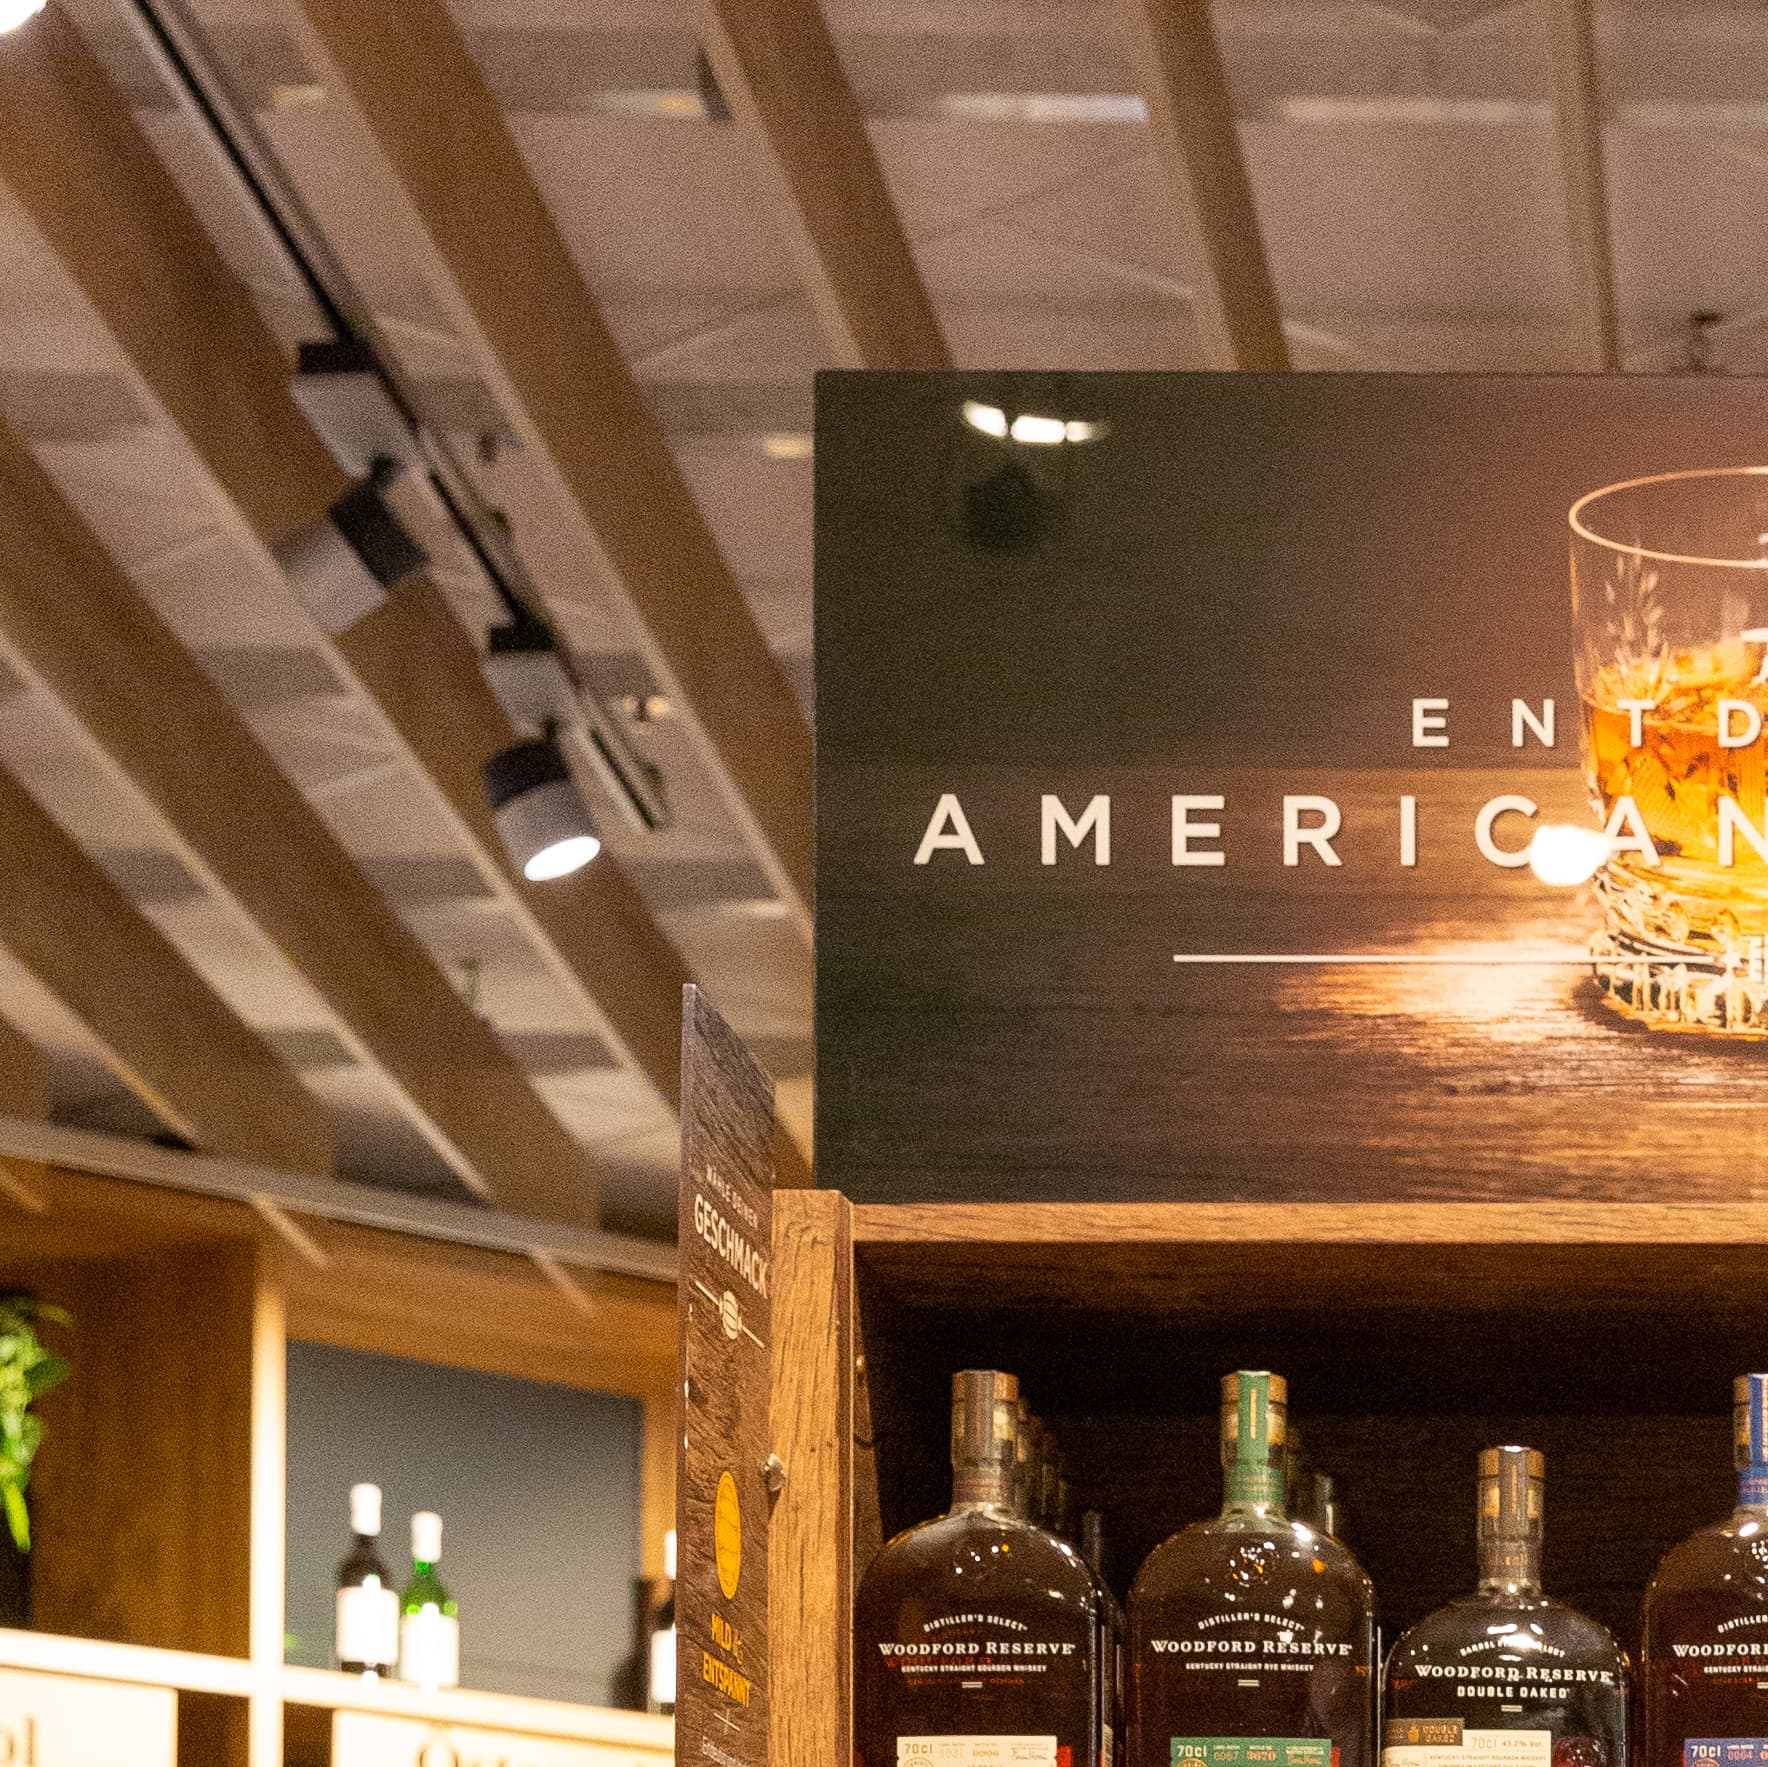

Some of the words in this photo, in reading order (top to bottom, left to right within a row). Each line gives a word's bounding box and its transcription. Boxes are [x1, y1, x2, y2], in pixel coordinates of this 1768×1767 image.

[694, 1193, 768, 1299] GESCHMACK
[879, 1643, 980, 1656] WOODFORD
[985, 1642, 1073, 1656] RESERVE
[1151, 1640, 1255, 1654] WOODFORD
[1263, 1640, 1349, 1655] RESERVE
[1457, 1686, 1512, 1698] DOUBLE
[1520, 1687, 1567, 1698] OAKED
